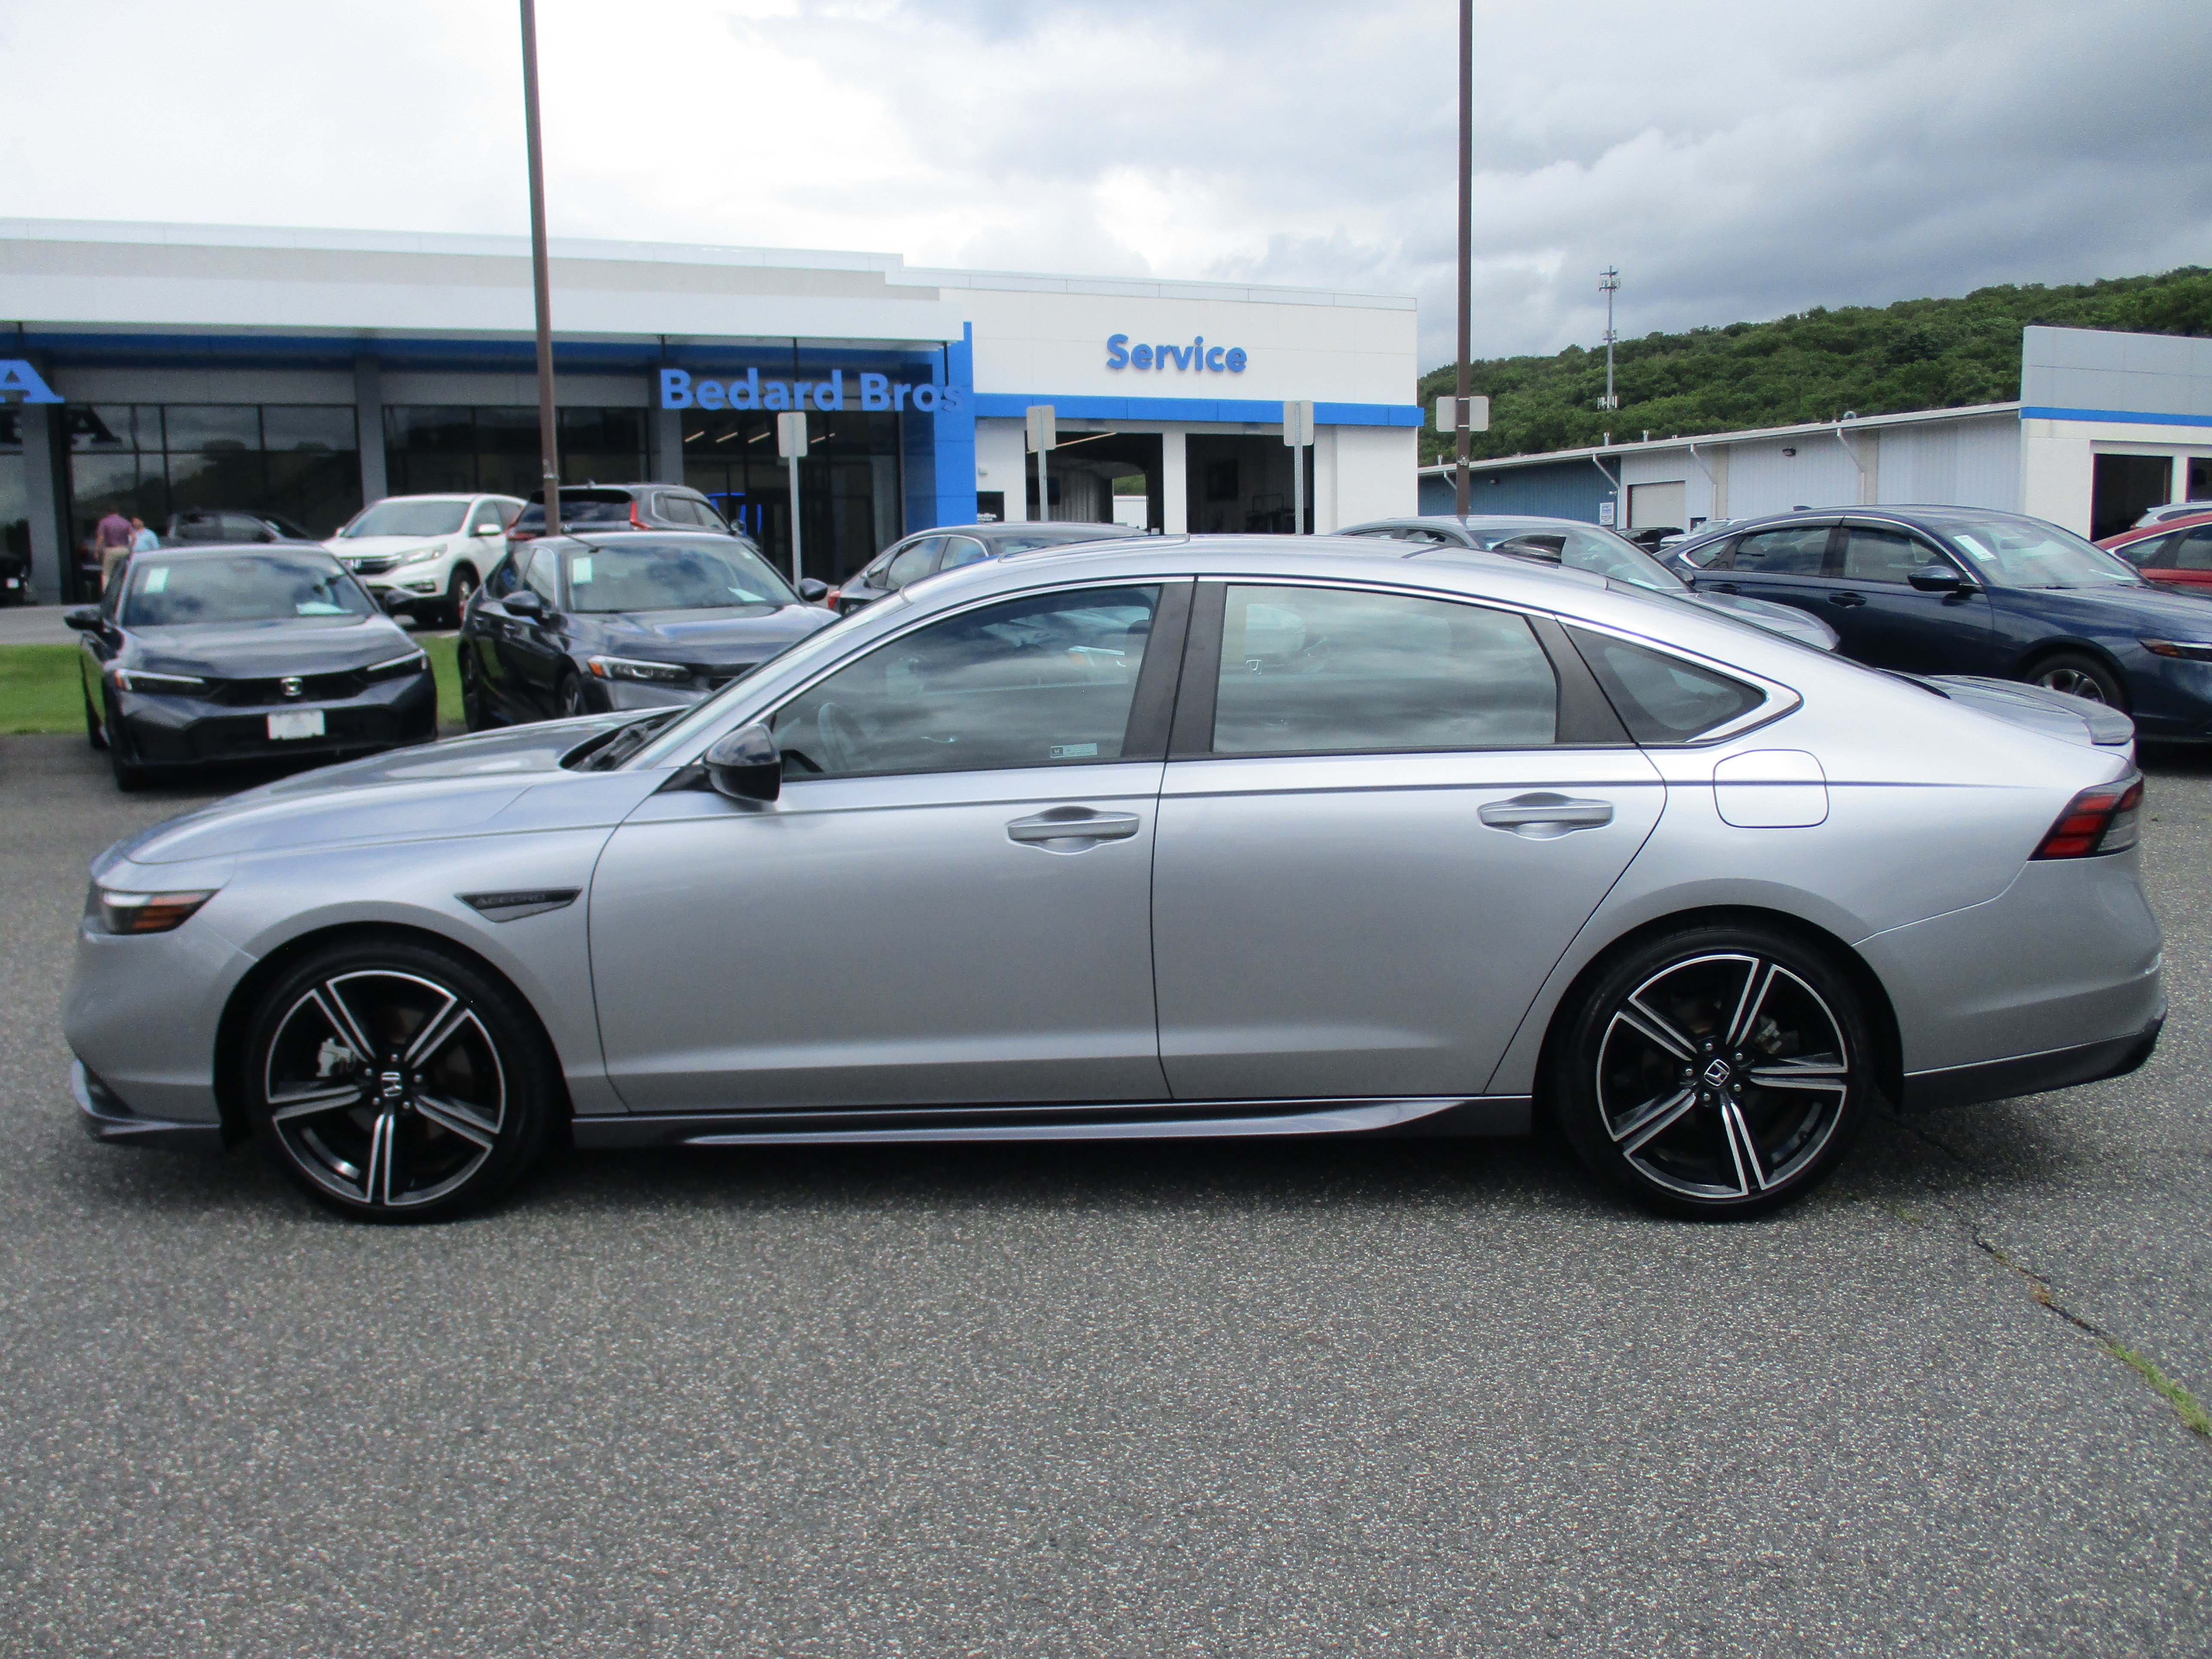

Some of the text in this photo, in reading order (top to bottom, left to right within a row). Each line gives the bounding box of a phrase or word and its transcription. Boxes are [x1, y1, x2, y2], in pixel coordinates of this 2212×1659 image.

[1106, 333, 1247, 372] Service
[660, 368, 963, 412] Bedard Bros
